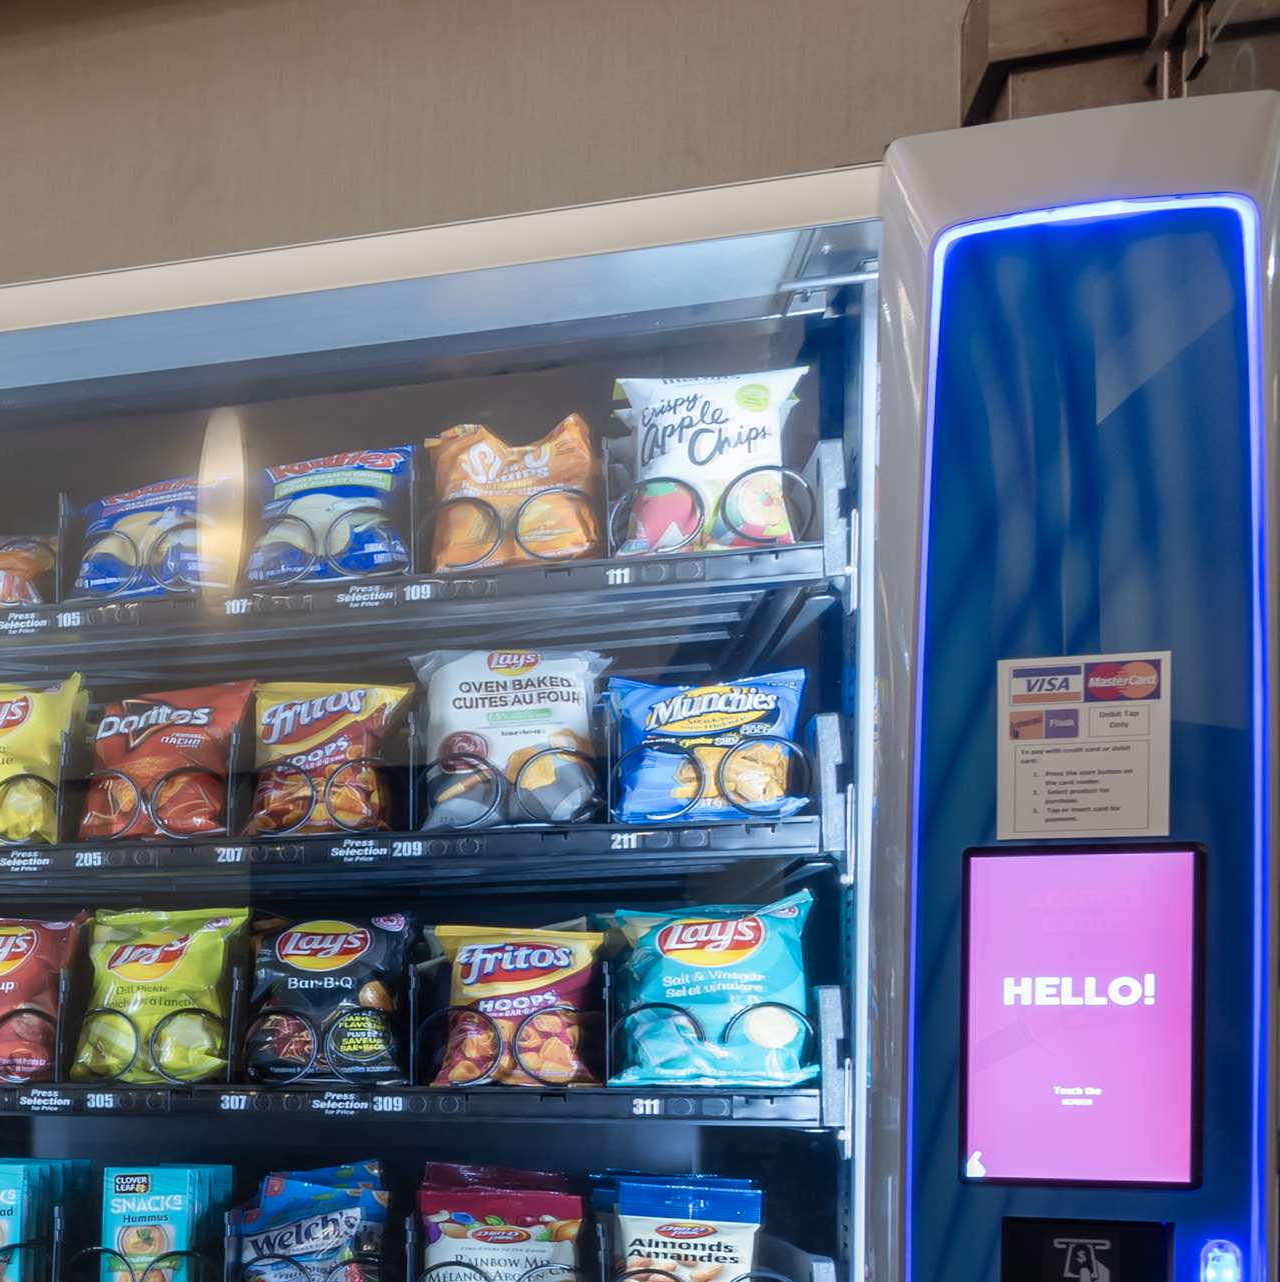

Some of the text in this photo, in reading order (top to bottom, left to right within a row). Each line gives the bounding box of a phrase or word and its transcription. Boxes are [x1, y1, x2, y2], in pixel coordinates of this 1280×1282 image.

[641, 393, 703, 425] Crispy
[643, 400, 730, 465] Apple
[688, 424, 772, 465] Chips
[606, 568, 631, 585] 111
[336, 591, 394, 603] Selection
[349, 585, 380, 594] Press
[402, 584, 432, 601] 109
[6, 611, 36, 621] Press
[56, 612, 81, 628] 105
[458, 676, 573, 694] OVEN BAKED
[1025, 673, 1156, 693] VISA MasterCard
[451, 696, 509, 710] CUITES
[511, 693, 534, 707] AU
[261, 688, 367, 745] Fritos
[644, 688, 778, 732] Munchies
[1099, 709, 1140, 720] Debit Tap
[97, 705, 211, 740] Doritos
[1109, 720, 1130, 731] Only
[342, 838, 375, 847] Press
[392, 841, 423, 857] 209
[610, 832, 639, 850] 211
[9, 850, 39, 859] Press
[74, 851, 102, 867] 205
[216, 847, 241, 863] 207
[330, 846, 388, 857] Selection
[0, 857, 50, 868] Selection
[285, 930, 367, 960] Lay's
[456, 943, 571, 986] Fritos
[662, 972, 690, 988] Salt
[709, 970, 766, 983] Vinegar
[665, 986, 686, 999] Sel
[687, 986, 701, 996] et
[1003, 973, 1156, 1006] HELLO!
[479, 991, 557, 1012] HOOPS
[30, 1088, 60, 1098] Press
[324, 1091, 356, 1100] Press
[1053, 1086, 1082, 1095] Touch
[19, 1095, 71, 1106] Selection
[86, 1093, 114, 1109] 305
[220, 1094, 247, 1110] 307
[311, 1098, 368, 1110] Selection
[373, 1096, 404, 1112] 309
[632, 1098, 660, 1115] 311
[115, 1176, 148, 1185] CLOVER
[115, 1183, 136, 1193] LEAF
[110, 1194, 183, 1214] SNACKS
[122, 1212, 169, 1224] Hummus
[249, 1208, 361, 1257] Welch's
[628, 1238, 734, 1254] Almonds
[628, 1249, 740, 1264] Amandes
